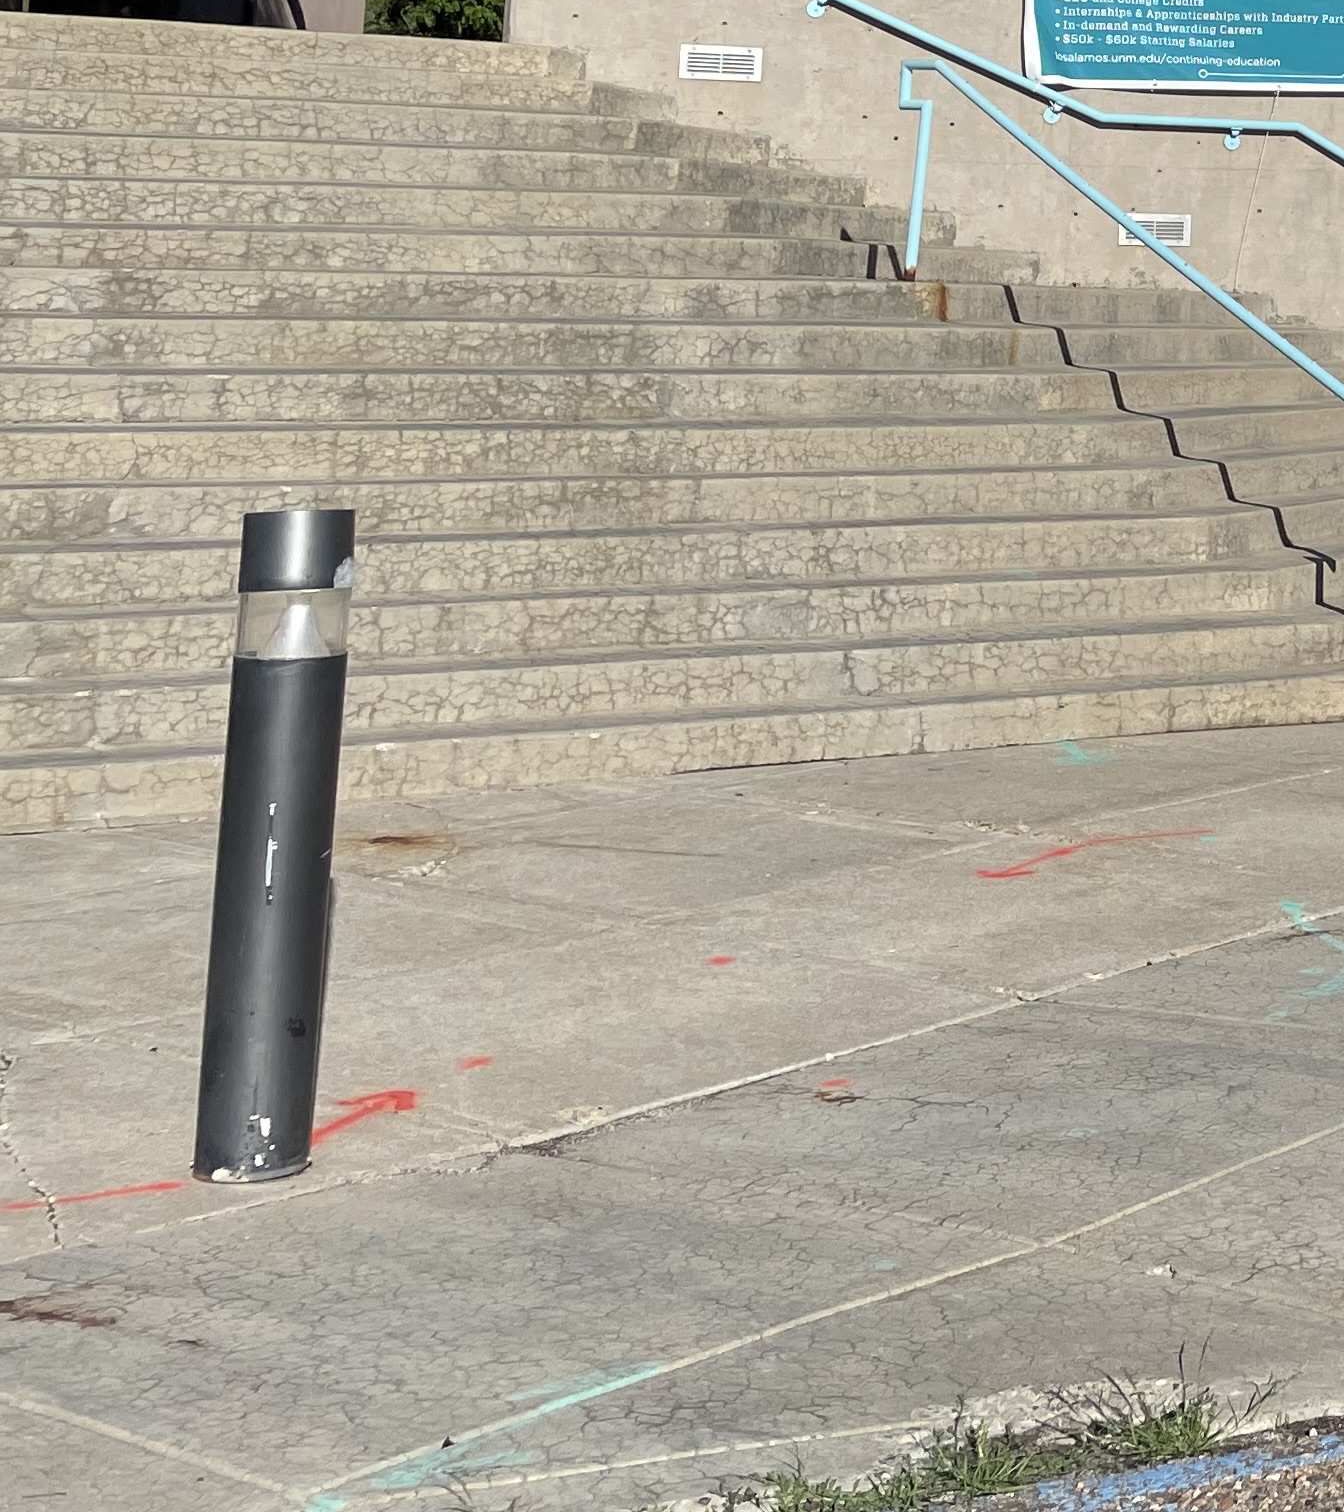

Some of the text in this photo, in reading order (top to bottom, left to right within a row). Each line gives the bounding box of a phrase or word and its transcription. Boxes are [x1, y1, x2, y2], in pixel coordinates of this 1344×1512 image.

[1063, 6, 1132, 19] Internships
[1135, 8, 1143, 18] &
[1146, 9, 1240, 22] Apprenticeships
[1243, 11, 1269, 22] with
[1271, 12, 1318, 25] Industry
[1063, 20, 1263, 36] In-demand and Rewarding Careers
[1062, 33, 1094, 45] $50k
[1105, 34, 1137, 45] $60k
[1139, 35, 1186, 48] Starting
[1188, 37, 1235, 48] Salaries
[1054, 50, 1281, 67] losalamos.unm.edu/continuing-education
